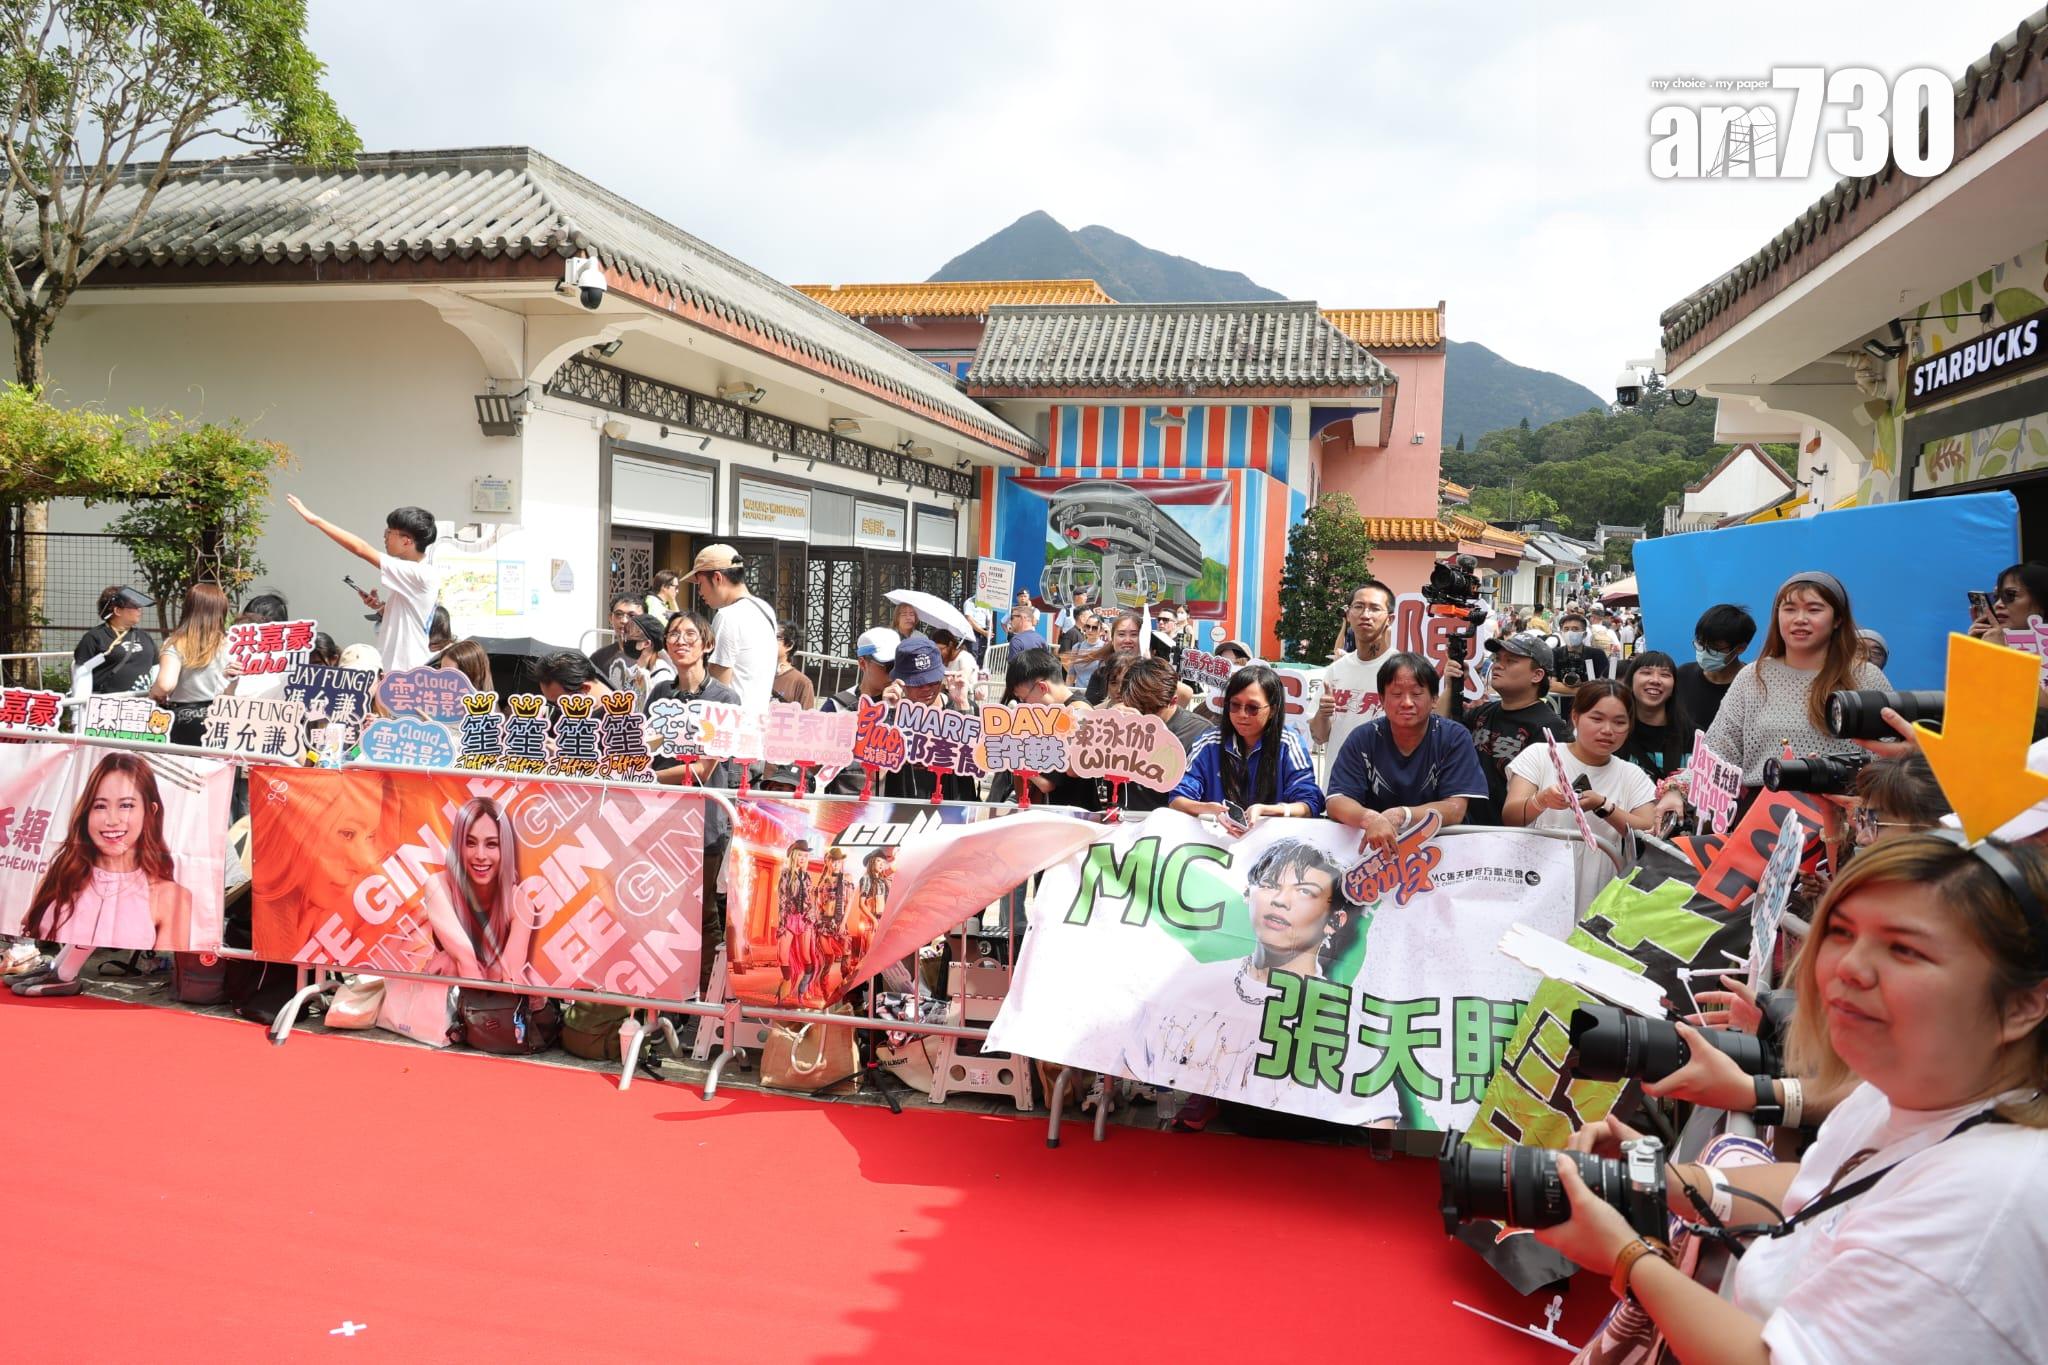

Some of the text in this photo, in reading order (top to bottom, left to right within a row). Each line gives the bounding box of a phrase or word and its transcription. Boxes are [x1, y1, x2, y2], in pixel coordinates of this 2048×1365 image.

[1913, 319, 2040, 397] STARBUCKS
[229, 621, 316, 656] 洪嘉豪
[290, 666, 365, 692] JAY FUNG
[414, 673, 459, 691] Cloud
[211, 698, 245, 719] JAY
[249, 701, 293, 725] FUNG
[705, 706, 741, 728] IVY
[982, 706, 1061, 735] DAY
[399, 723, 440, 746] Cloud
[505, 716, 548, 759] 笙
[556, 717, 598, 760] 笙
[602, 714, 647, 756] 笙
[768, 711, 853, 747] 王家晴
[456, 753, 498, 770] Jeffre
[497, 754, 548, 774] Jeffrey
[547, 755, 599, 777] Jeffrey
[601, 754, 651, 777] Jeffrey
[1064, 836, 1234, 931] MC
